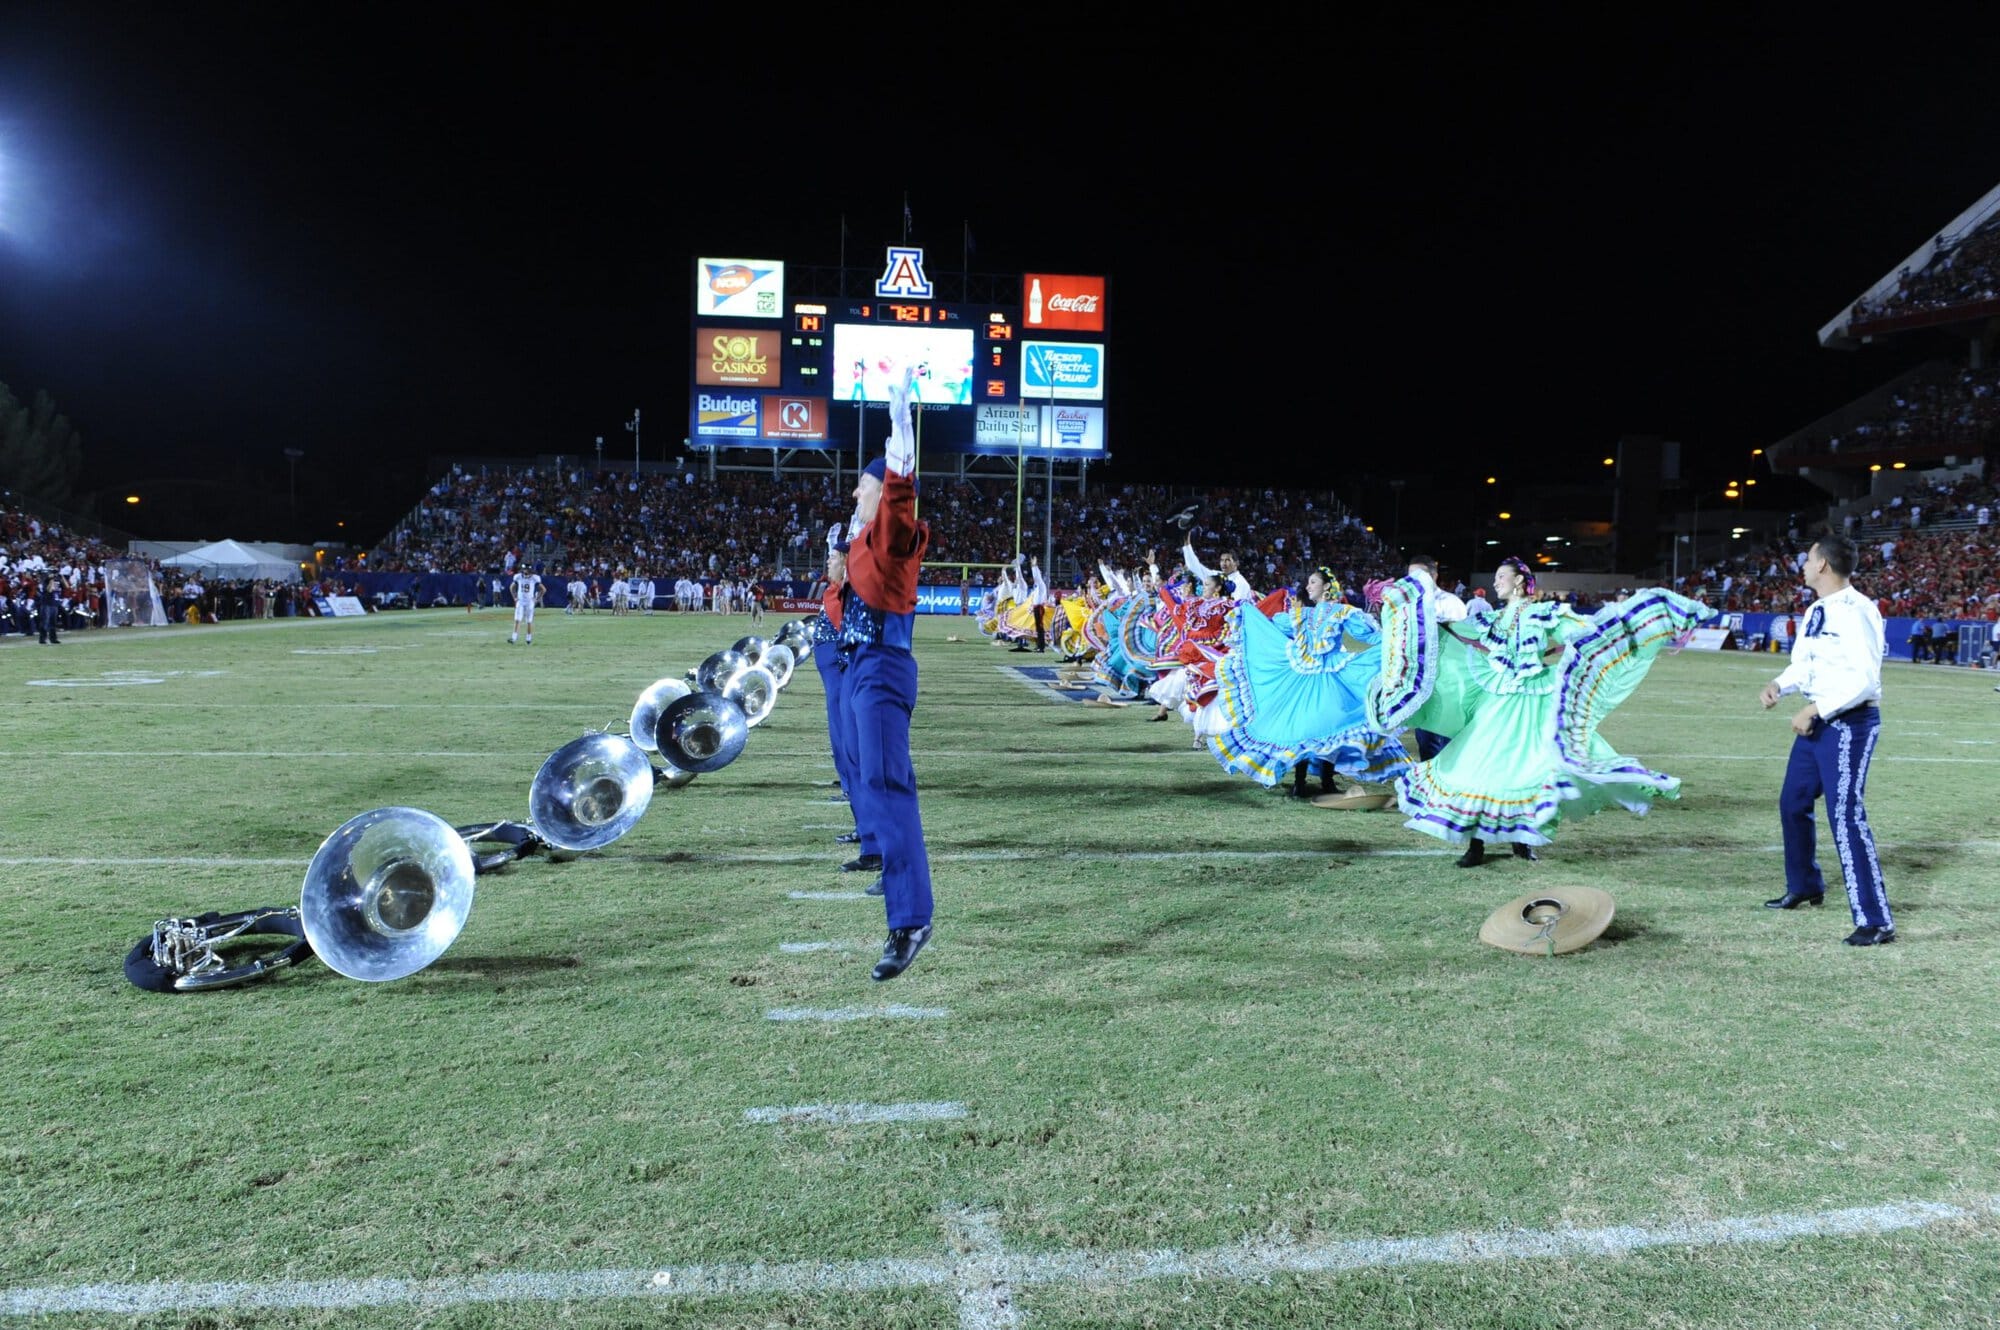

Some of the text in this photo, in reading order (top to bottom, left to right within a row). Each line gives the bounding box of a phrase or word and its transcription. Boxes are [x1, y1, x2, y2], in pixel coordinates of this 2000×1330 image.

[875, 246, 933, 299] A
[862, 305, 870, 317] 3
[889, 304, 930, 322] 7:21
[938, 309, 946, 321] 3
[989, 325, 1011, 339] 24
[712, 336, 767, 363] SOL
[1044, 349, 1083, 362] Tucson
[993, 354, 1001, 366] 3
[1047, 359, 1092, 373] Electric
[711, 361, 767, 375] CASINOS
[1053, 371, 1092, 383] Power
[698, 395, 757, 416] Budget
[983, 406, 1030, 419] Arizona
[788, 405, 807, 425] K
[977, 420, 1037, 434] Daily Star
[783, 601, 795, 609] Go
